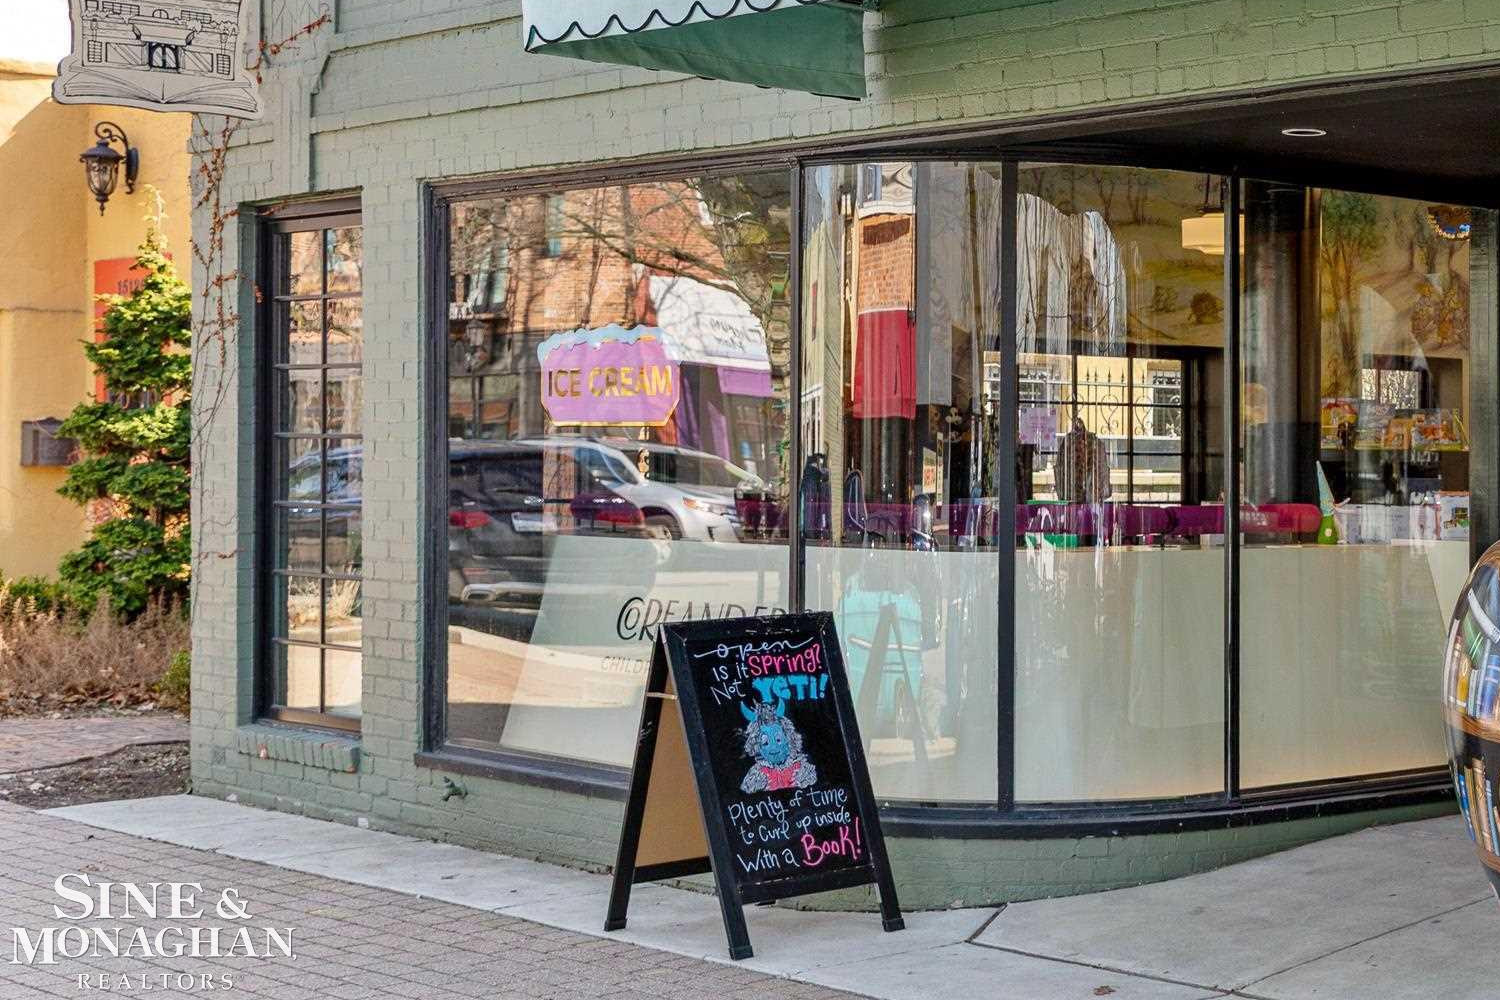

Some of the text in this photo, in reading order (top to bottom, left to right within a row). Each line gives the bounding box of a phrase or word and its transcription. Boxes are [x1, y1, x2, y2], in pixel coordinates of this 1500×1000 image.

[548, 365, 673, 398] ICE CREAM
[694, 636, 814, 660] open
[736, 662, 749, 680] it
[710, 678, 746, 705] Not
[728, 787, 848, 826] Plenty of time
[739, 825, 755, 845] to
[795, 815, 812, 834] up
[814, 805, 851, 826] inside
[781, 848, 801, 868] a
